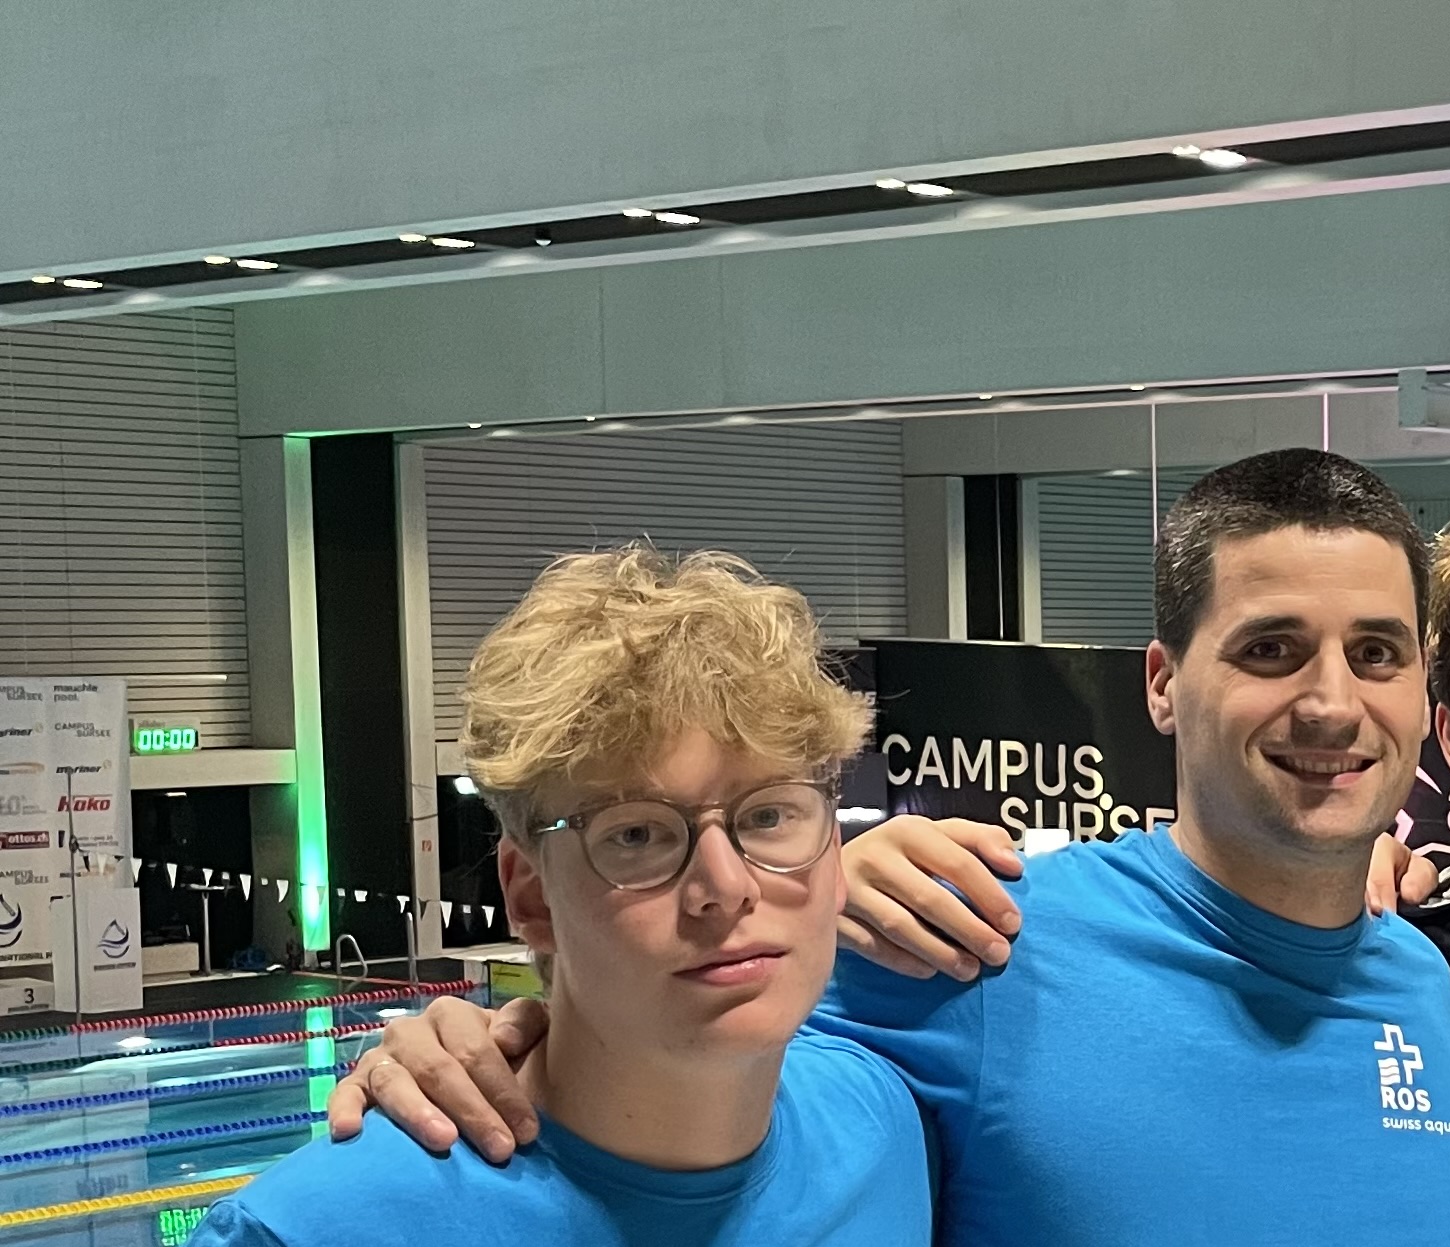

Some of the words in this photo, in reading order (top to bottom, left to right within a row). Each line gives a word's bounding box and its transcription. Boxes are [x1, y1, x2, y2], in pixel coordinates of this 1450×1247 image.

[54, 722, 95, 730] CAMPUS
[137, 728, 195, 750] 00:00
[882, 733, 1104, 799] CAMPUS
[23, 988, 35, 1004] 3
[1382, 1117, 1422, 1130] swiss
